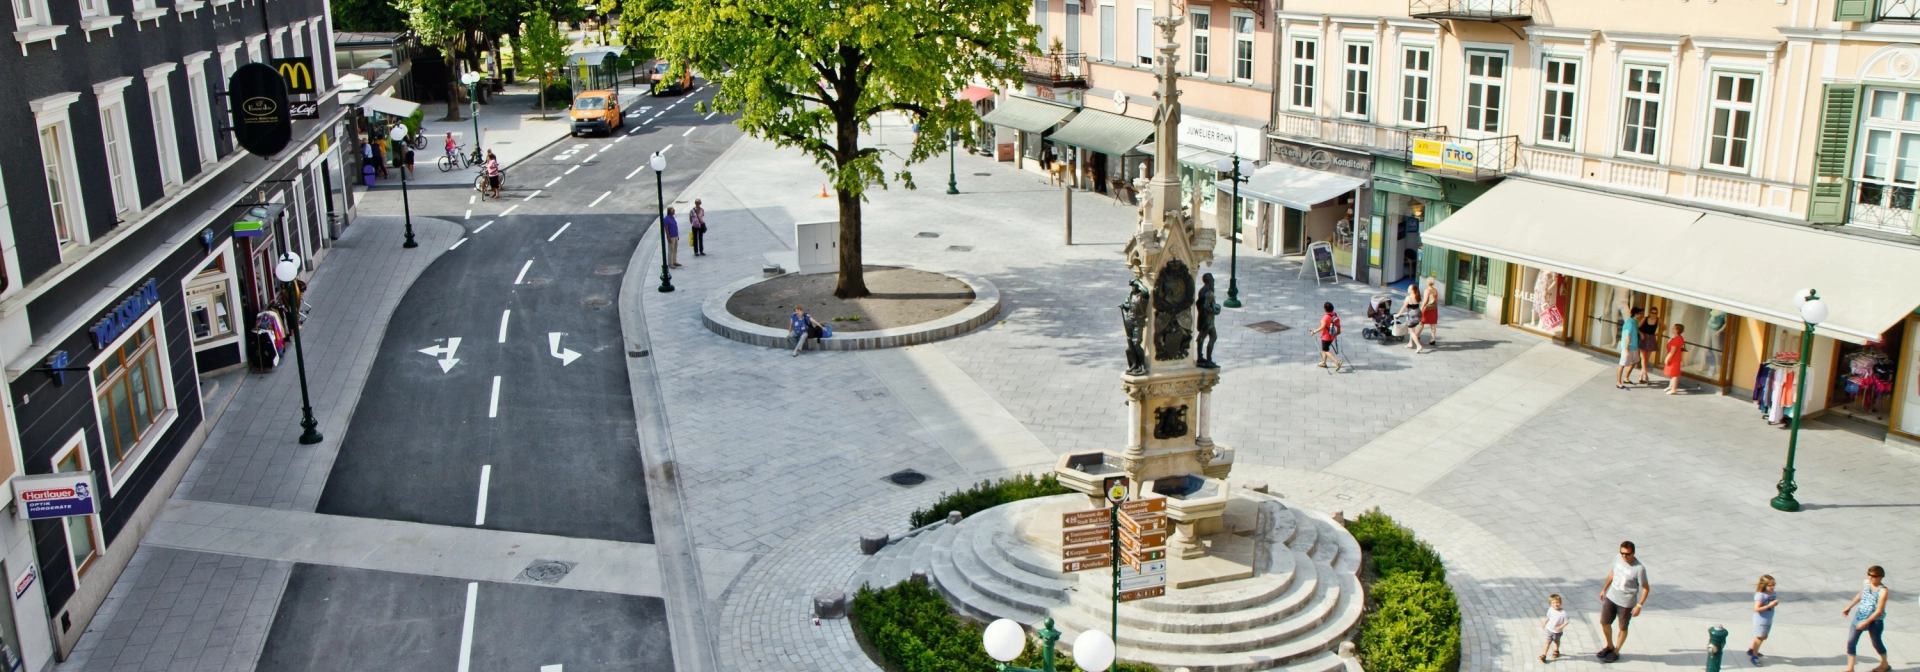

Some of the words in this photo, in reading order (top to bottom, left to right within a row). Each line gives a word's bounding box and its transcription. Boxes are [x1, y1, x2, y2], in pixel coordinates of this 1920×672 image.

[1187, 126, 1215, 139] JUWELIER
[1216, 132, 1232, 143] ROHN
[1333, 156, 1371, 171] Konditorei
[1514, 288, 1535, 302] SALE
[93, 277, 159, 350] VOLKSBANK
[26, 490, 72, 500] Hartlauer
[1070, 548, 1089, 556] Kurpark
[1081, 561, 1104, 569] Apotheke
